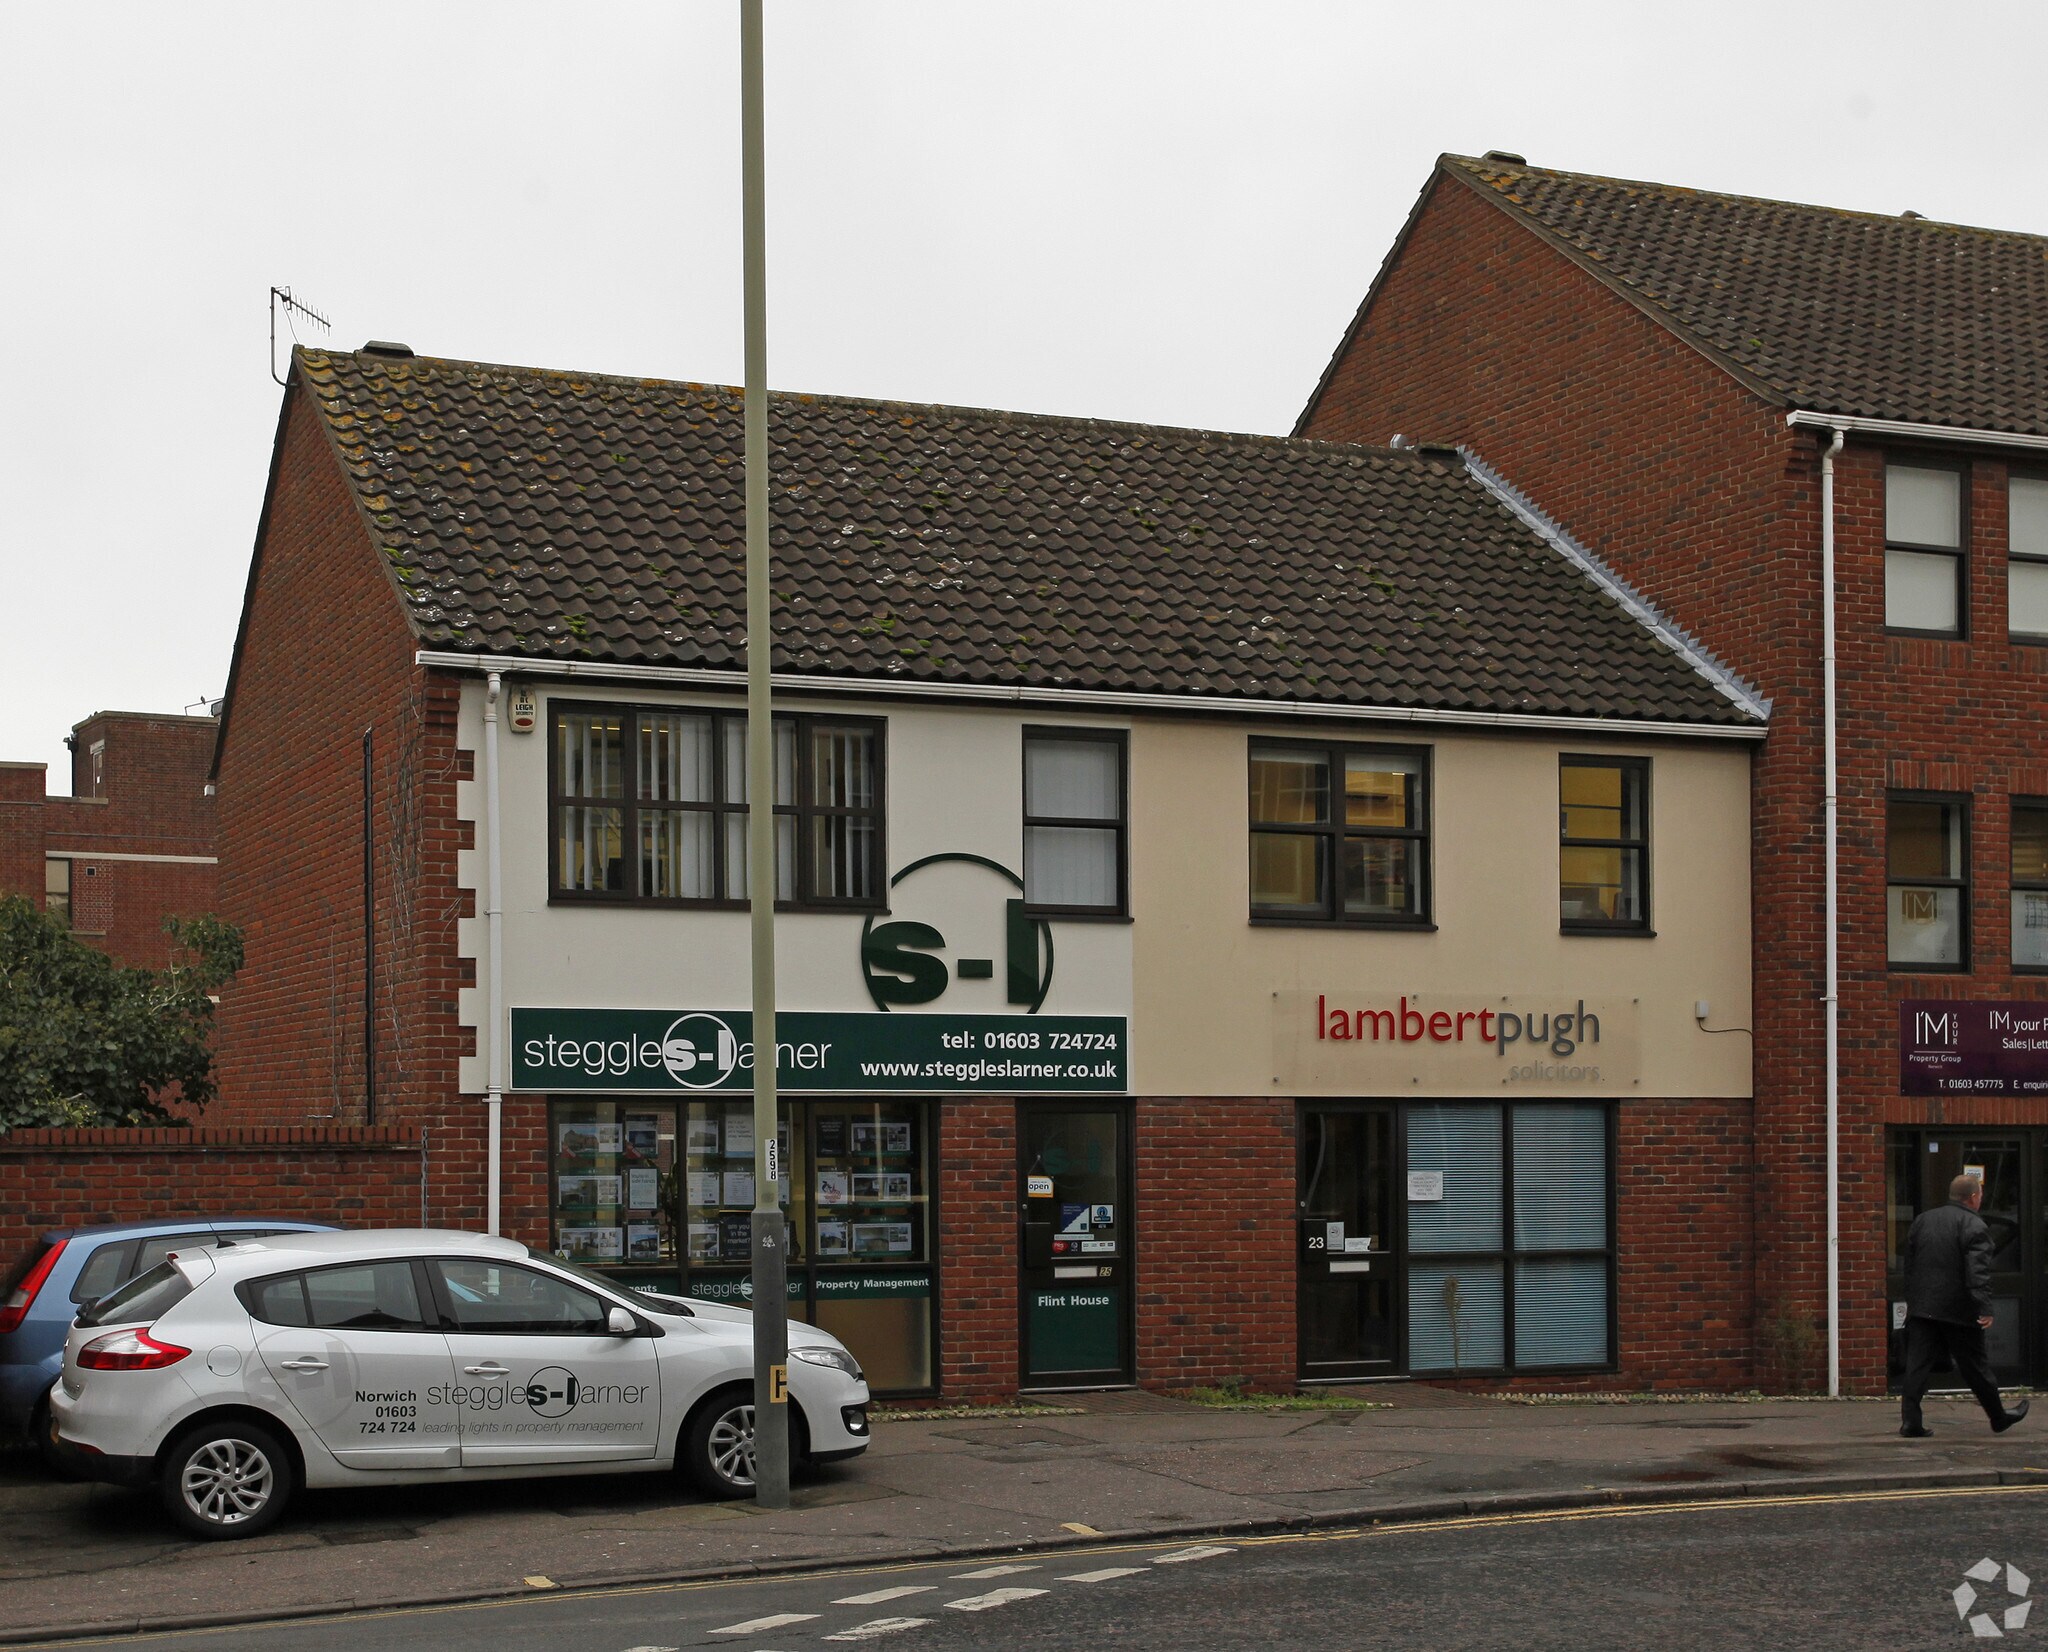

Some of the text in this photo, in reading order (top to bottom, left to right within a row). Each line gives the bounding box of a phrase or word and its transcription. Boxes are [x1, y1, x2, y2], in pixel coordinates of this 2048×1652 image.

[1317, 995, 1600, 1056] lambertpugh
[2013, 1020, 2040, 1034] your
[941, 1030, 1118, 1051] tel: 01603 724724
[1909, 1054, 1962, 1064] Property Group
[860, 1058, 1118, 1082] www.steggleslarner.co.uk
[1510, 1060, 1600, 1081] solicitors
[1948, 1080, 1973, 1090] 01603
[1974, 1080, 2004, 1090] 457775
[769, 1139, 777, 1180] 2598
[1028, 1183, 1049, 1191] open
[1308, 1237, 1325, 1249] 23
[1100, 1267, 1112, 1276] 25
[815, 1277, 930, 1291] Property Management
[1038, 1295, 1110, 1307] Flint House
[355, 1389, 417, 1402] Norwich
[375, 1405, 417, 1418] 01603
[359, 1421, 416, 1434] 724 724
[422, 1421, 644, 1436] leading lights in property management
